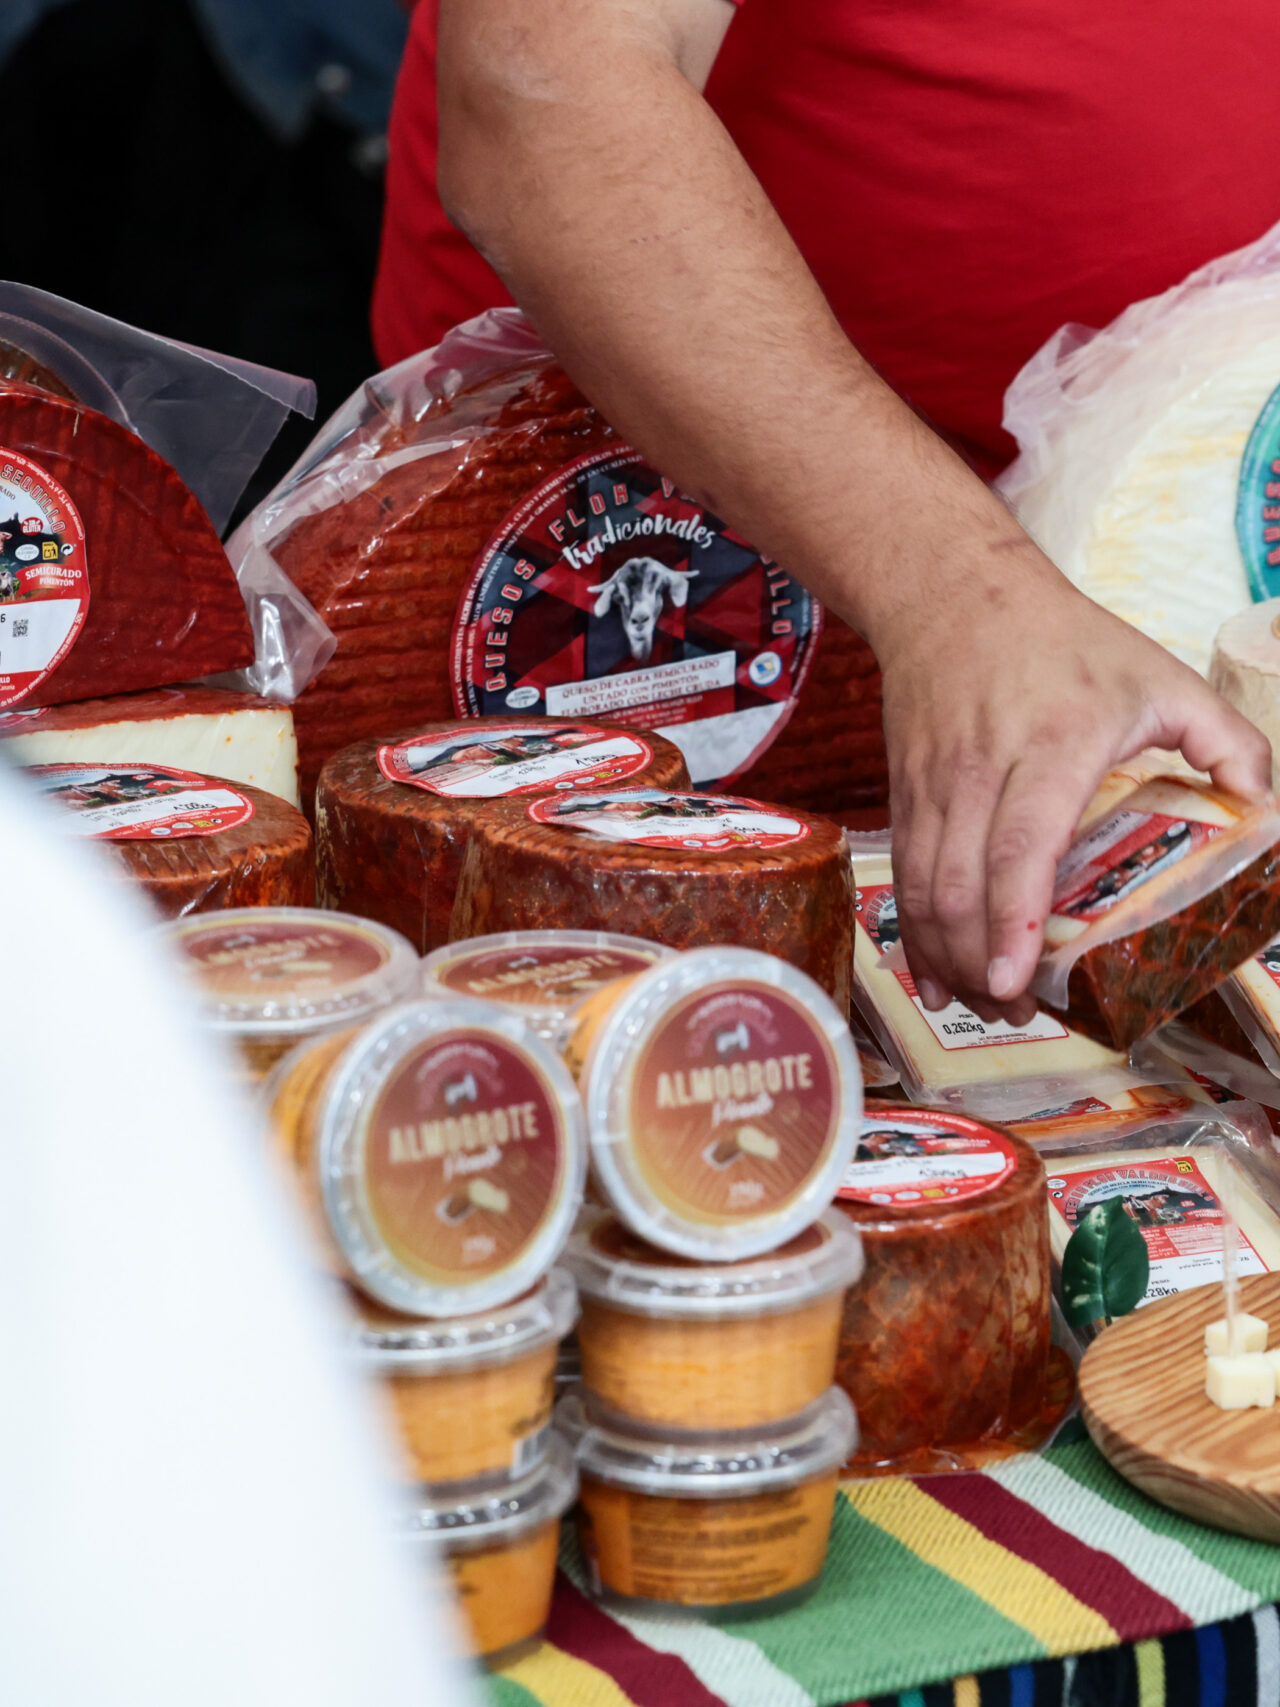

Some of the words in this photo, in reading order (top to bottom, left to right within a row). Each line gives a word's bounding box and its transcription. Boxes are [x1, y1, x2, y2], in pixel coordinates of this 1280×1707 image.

[558, 513, 717, 570] tradicionales
[25, 566, 82, 580] SEMICURADO
[485, 558, 536, 692] QUESOS
[548, 483, 629, 542] FLOR
[562, 684, 599, 699] QUESO
[599, 681, 613, 692] DE
[614, 674, 651, 688] CABRA
[653, 658, 720, 682] SEMICURADO
[583, 689, 629, 705] UNTADO
[626, 692, 650, 706] CON
[651, 687, 682, 701] LECHE
[942, 1019, 986, 1036] 0,262kg
[656, 1052, 814, 1110] ALMOGROTE
